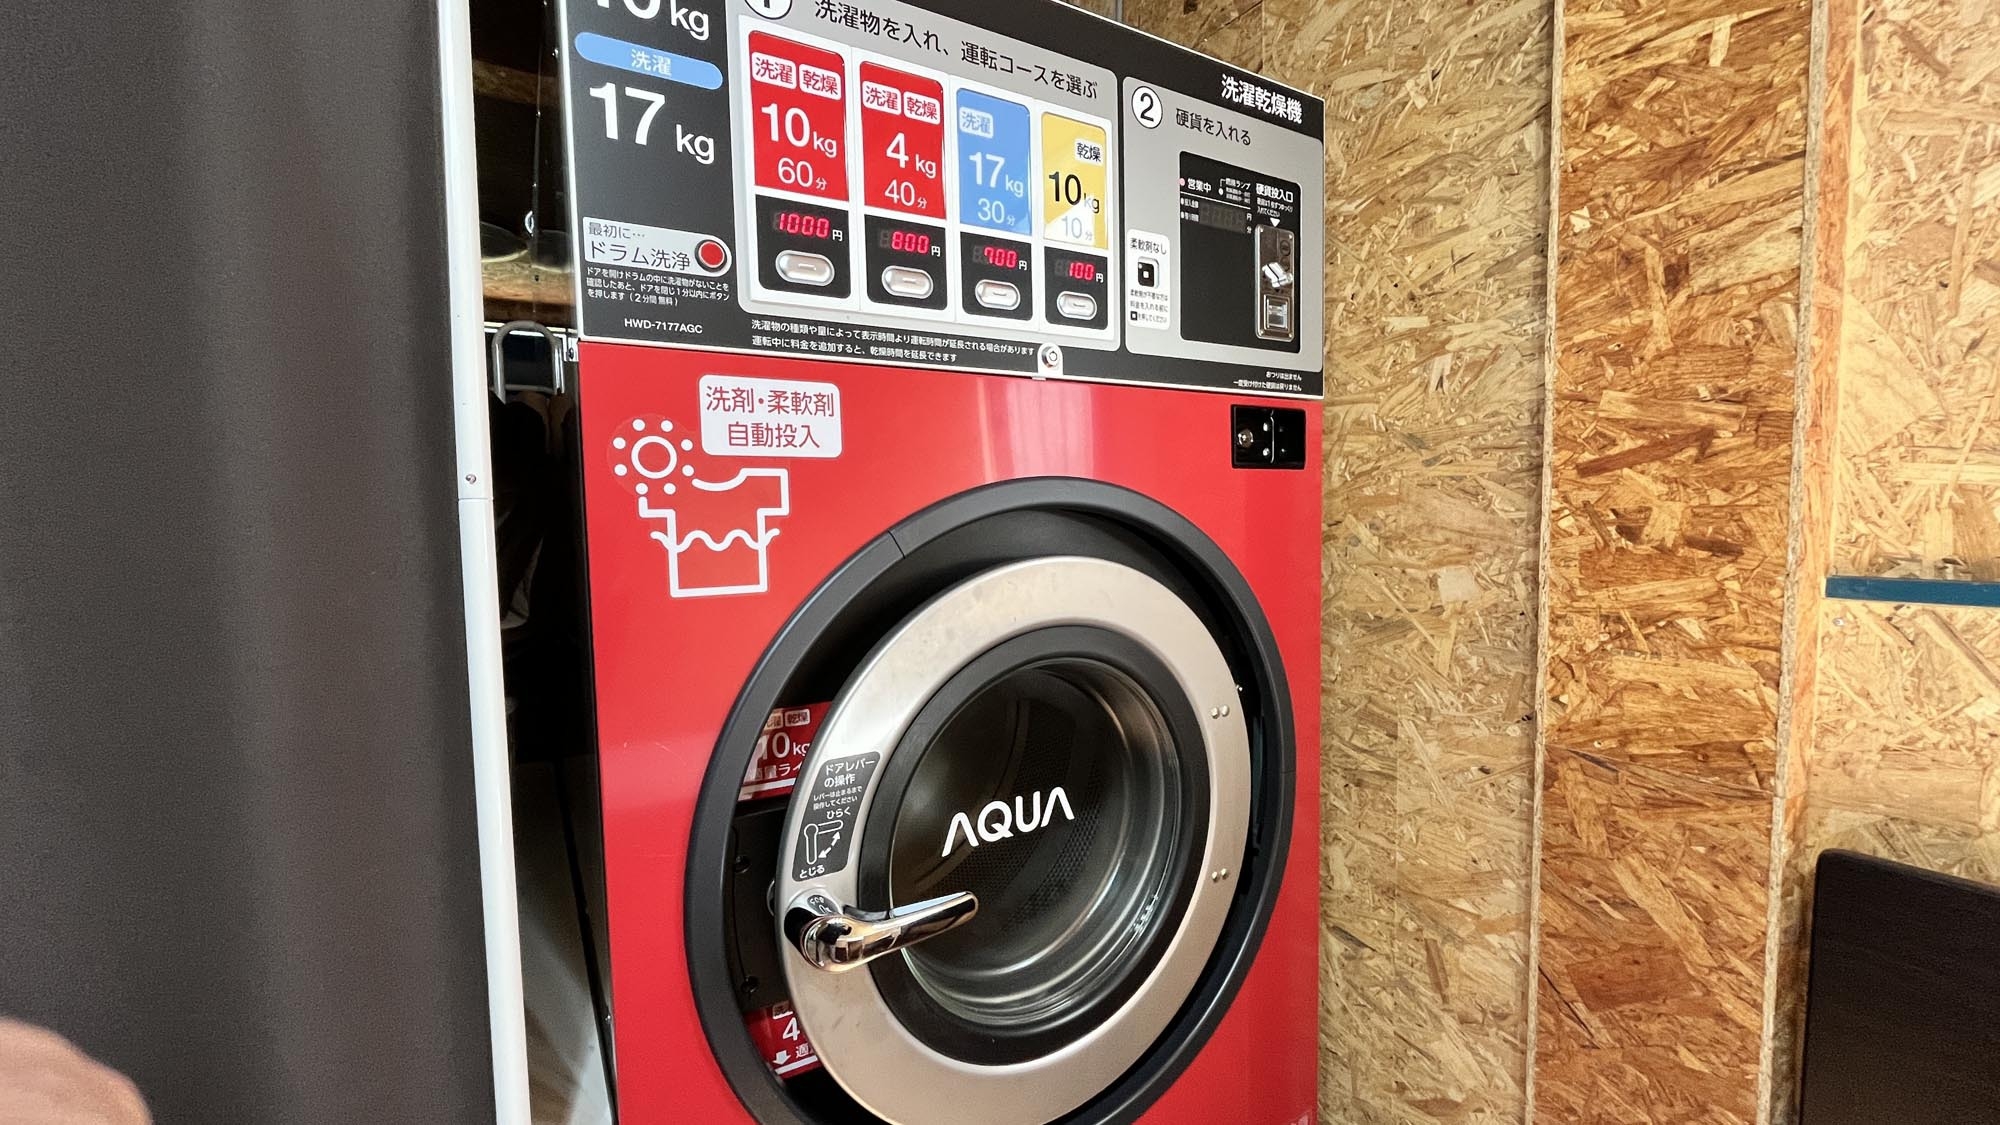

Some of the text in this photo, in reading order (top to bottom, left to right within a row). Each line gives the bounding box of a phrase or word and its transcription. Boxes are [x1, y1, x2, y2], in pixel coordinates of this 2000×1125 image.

[668, 0, 709, 41] kg
[631, 48, 673, 76] 洗濯
[755, 57, 838, 96] 洗濯 乾燥
[865, 85, 938, 121] 洗濯 乾燥
[1221, 73, 1302, 124] 洗濯乾燥機
[589, 82, 715, 164] 17 kg
[962, 110, 991, 134] 洗濯
[1176, 108, 1251, 146] 硬貨を入れる
[1077, 142, 1101, 162] 乾燥
[591, 241, 690, 271] ドラム洗浄
[624, 318, 703, 334] HWD-7177AGC
[706, 386, 834, 417] 洗剤・柔軟剤
[728, 421, 820, 448] 自動投入
[824, 773, 856, 788] の操作
[825, 758, 875, 776] ドアレバー
[826, 807, 851, 820] ひらく
[941, 786, 1075, 857] AQUA
[800, 864, 825, 879] とじる
